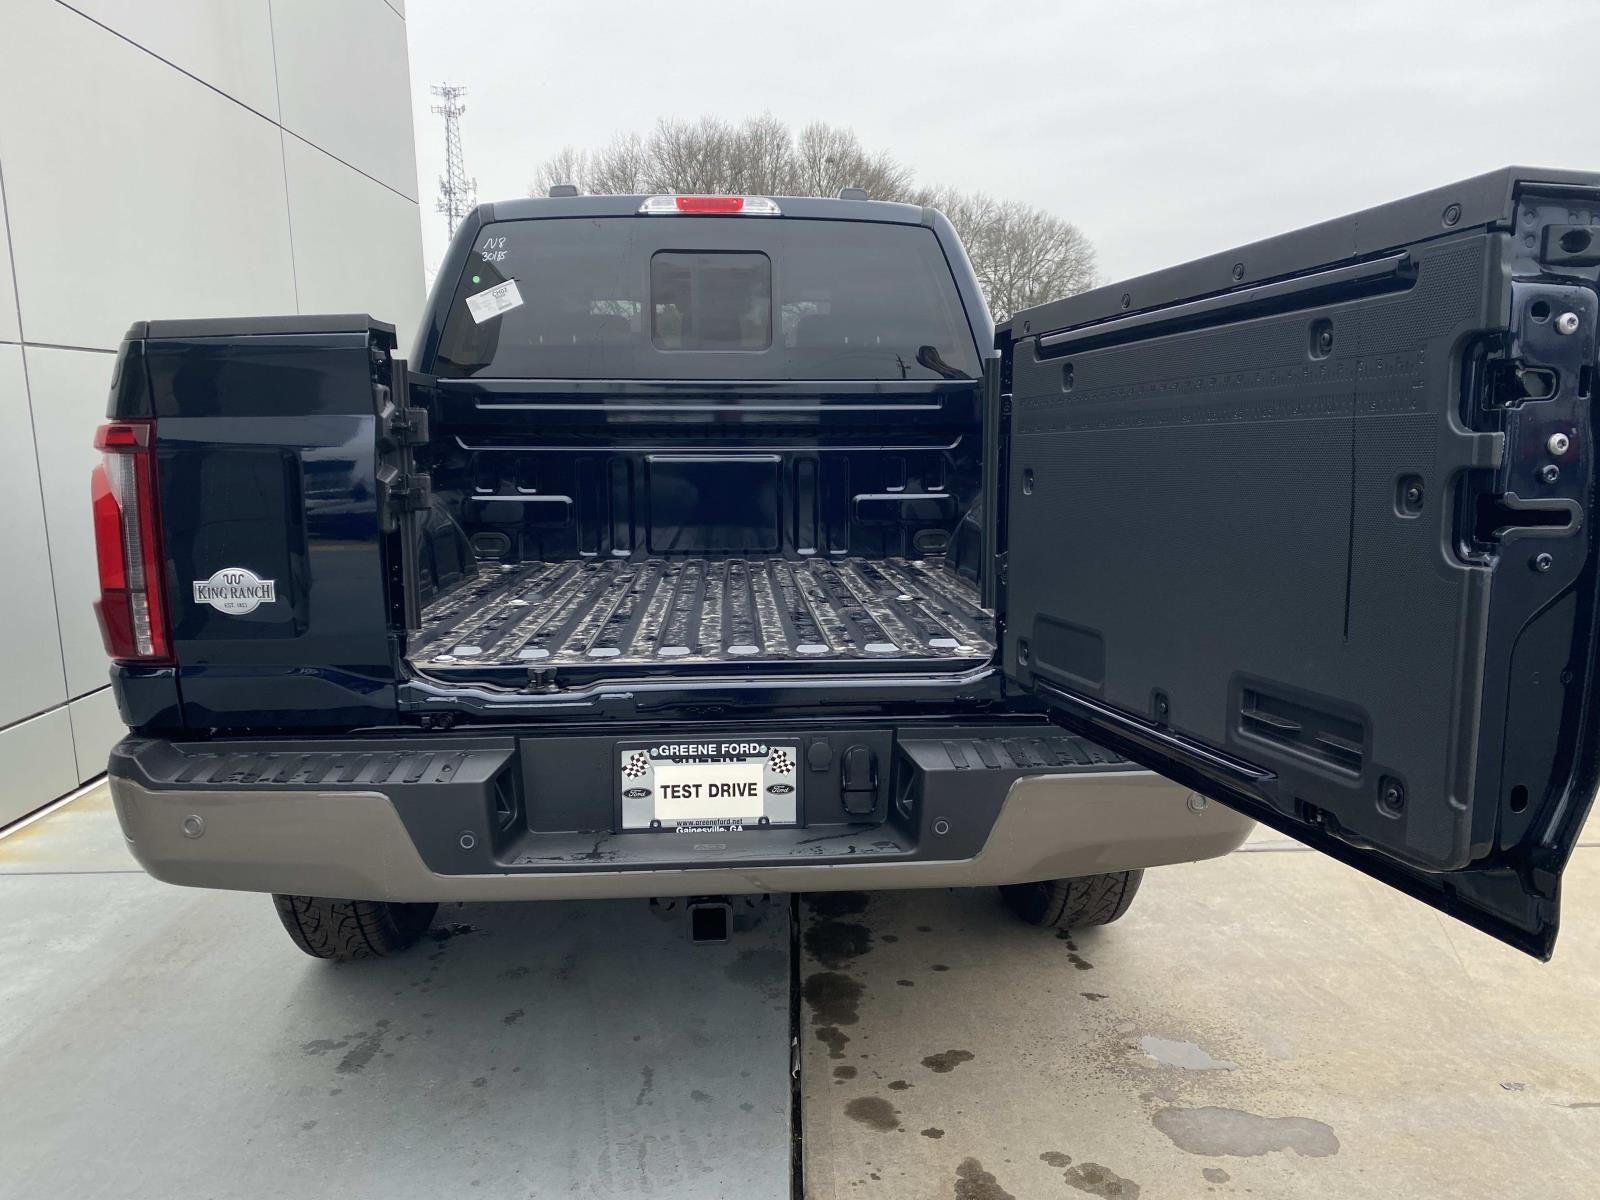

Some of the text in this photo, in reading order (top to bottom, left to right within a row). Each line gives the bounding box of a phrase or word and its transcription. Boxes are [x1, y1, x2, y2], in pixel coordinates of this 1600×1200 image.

[197, 585, 271, 599] KING RANCH
[659, 743, 759, 756] GREENE FORD
[660, 783, 757, 799] TEST DRIVE
